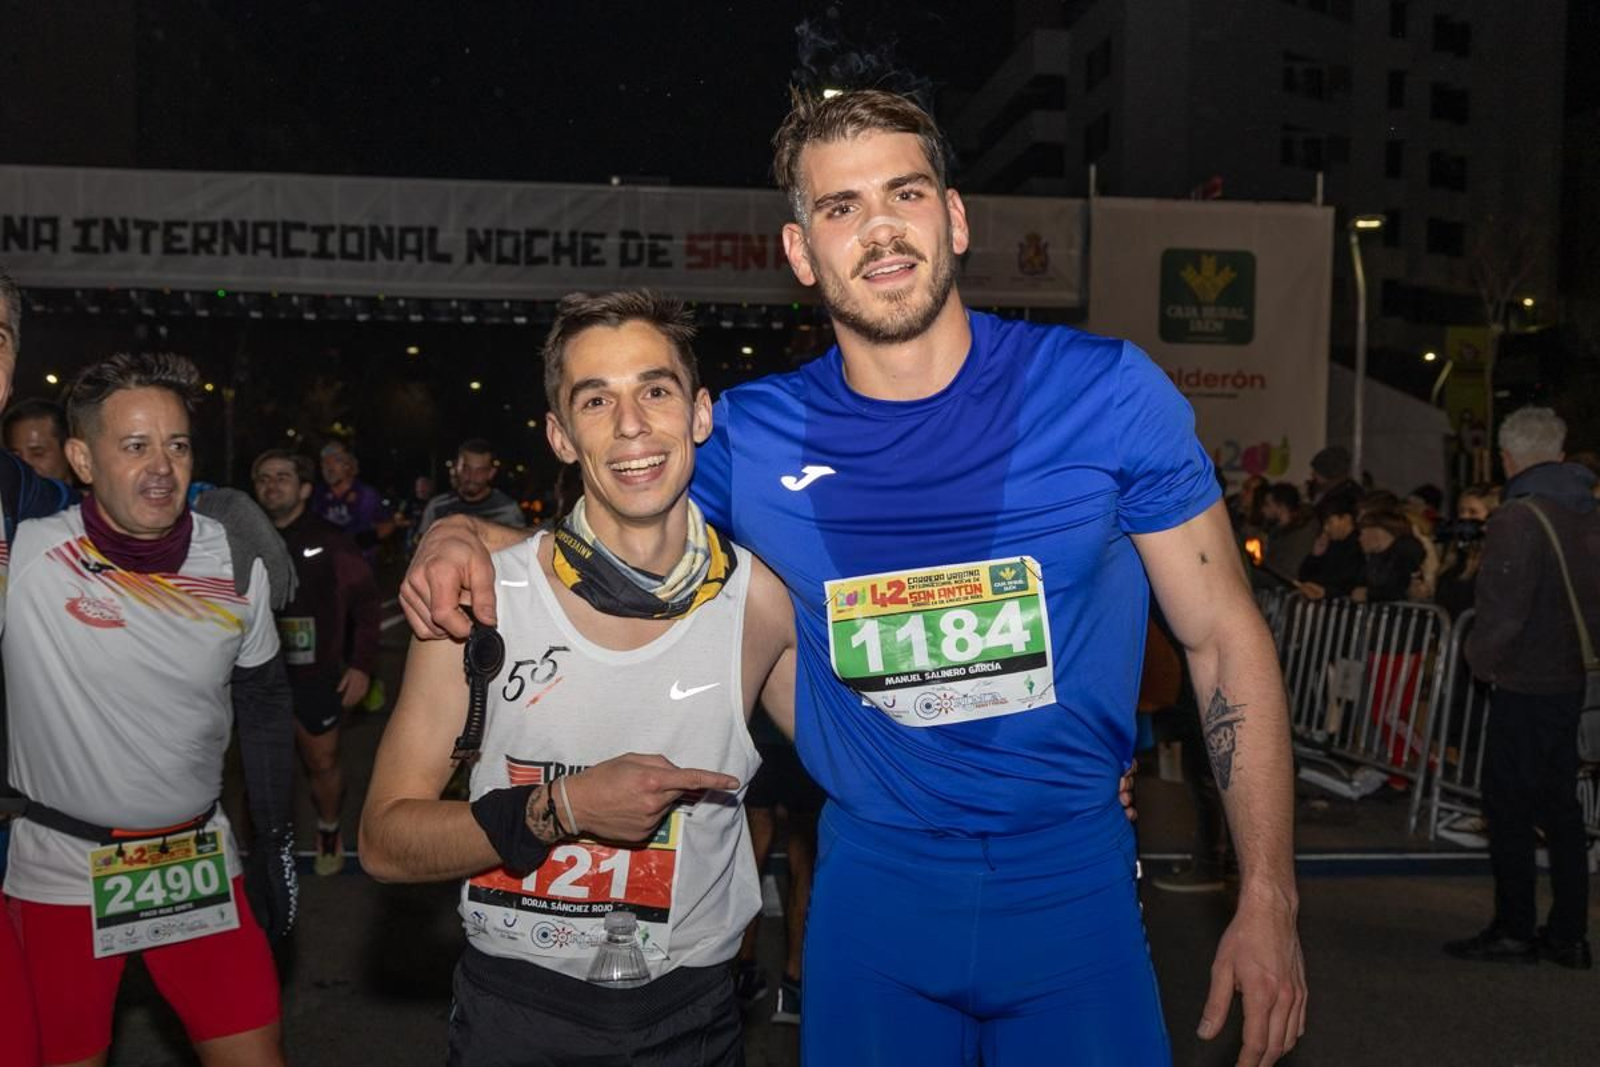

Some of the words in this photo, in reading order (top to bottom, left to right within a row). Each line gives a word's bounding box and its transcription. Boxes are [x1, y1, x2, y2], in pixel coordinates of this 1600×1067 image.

[71, 217, 452, 264] INTERNACIONAL
[466, 228, 607, 267] NOCHE
[619, 231, 673, 268] DE
[684, 232, 768, 270] SAN
[870, 579, 908, 608] 42
[908, 588, 935, 604] SAN
[851, 600, 1031, 673] 1184
[502, 646, 571, 702] 55
[885, 673, 922, 686] MANUEL
[924, 667, 966, 681] SALINERO
[968, 661, 1002, 675] GARCÍA
[103, 859, 219, 917] 2490
[521, 897, 548, 909] BORJA
[550, 900, 590, 913] SÁNCHEZ
[592, 904, 613, 913] ROJO
